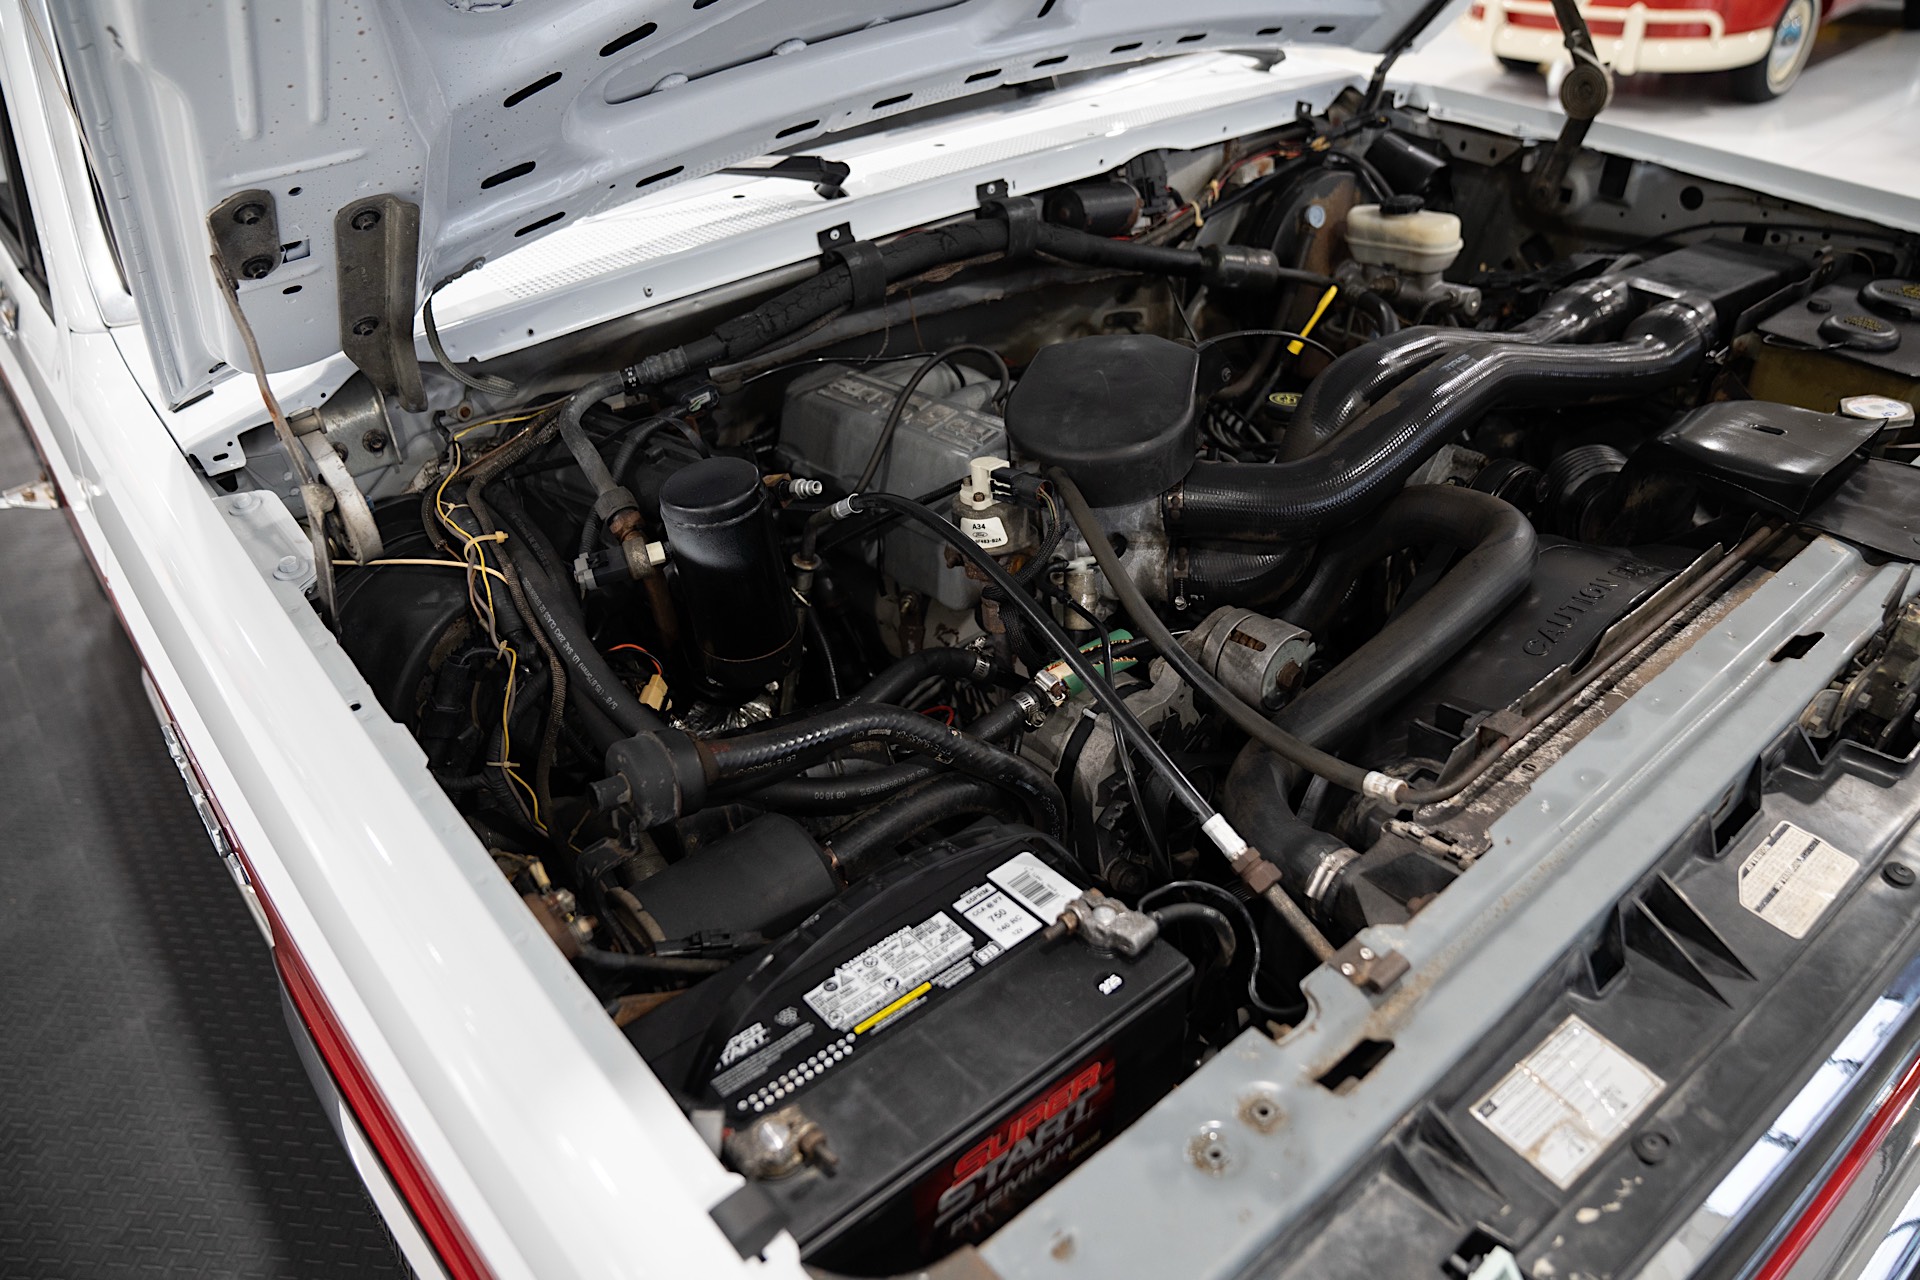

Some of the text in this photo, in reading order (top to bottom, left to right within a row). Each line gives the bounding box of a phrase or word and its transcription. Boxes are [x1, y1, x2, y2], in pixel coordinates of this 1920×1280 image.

[562, 640, 575, 654] SAE
[1520, 574, 1619, 659] CAUTION
[986, 906, 1008, 924] 750
[934, 1084, 1103, 1226] START
[954, 1062, 1102, 1177] SUPER
[950, 1134, 1073, 1235] PREMIUM
